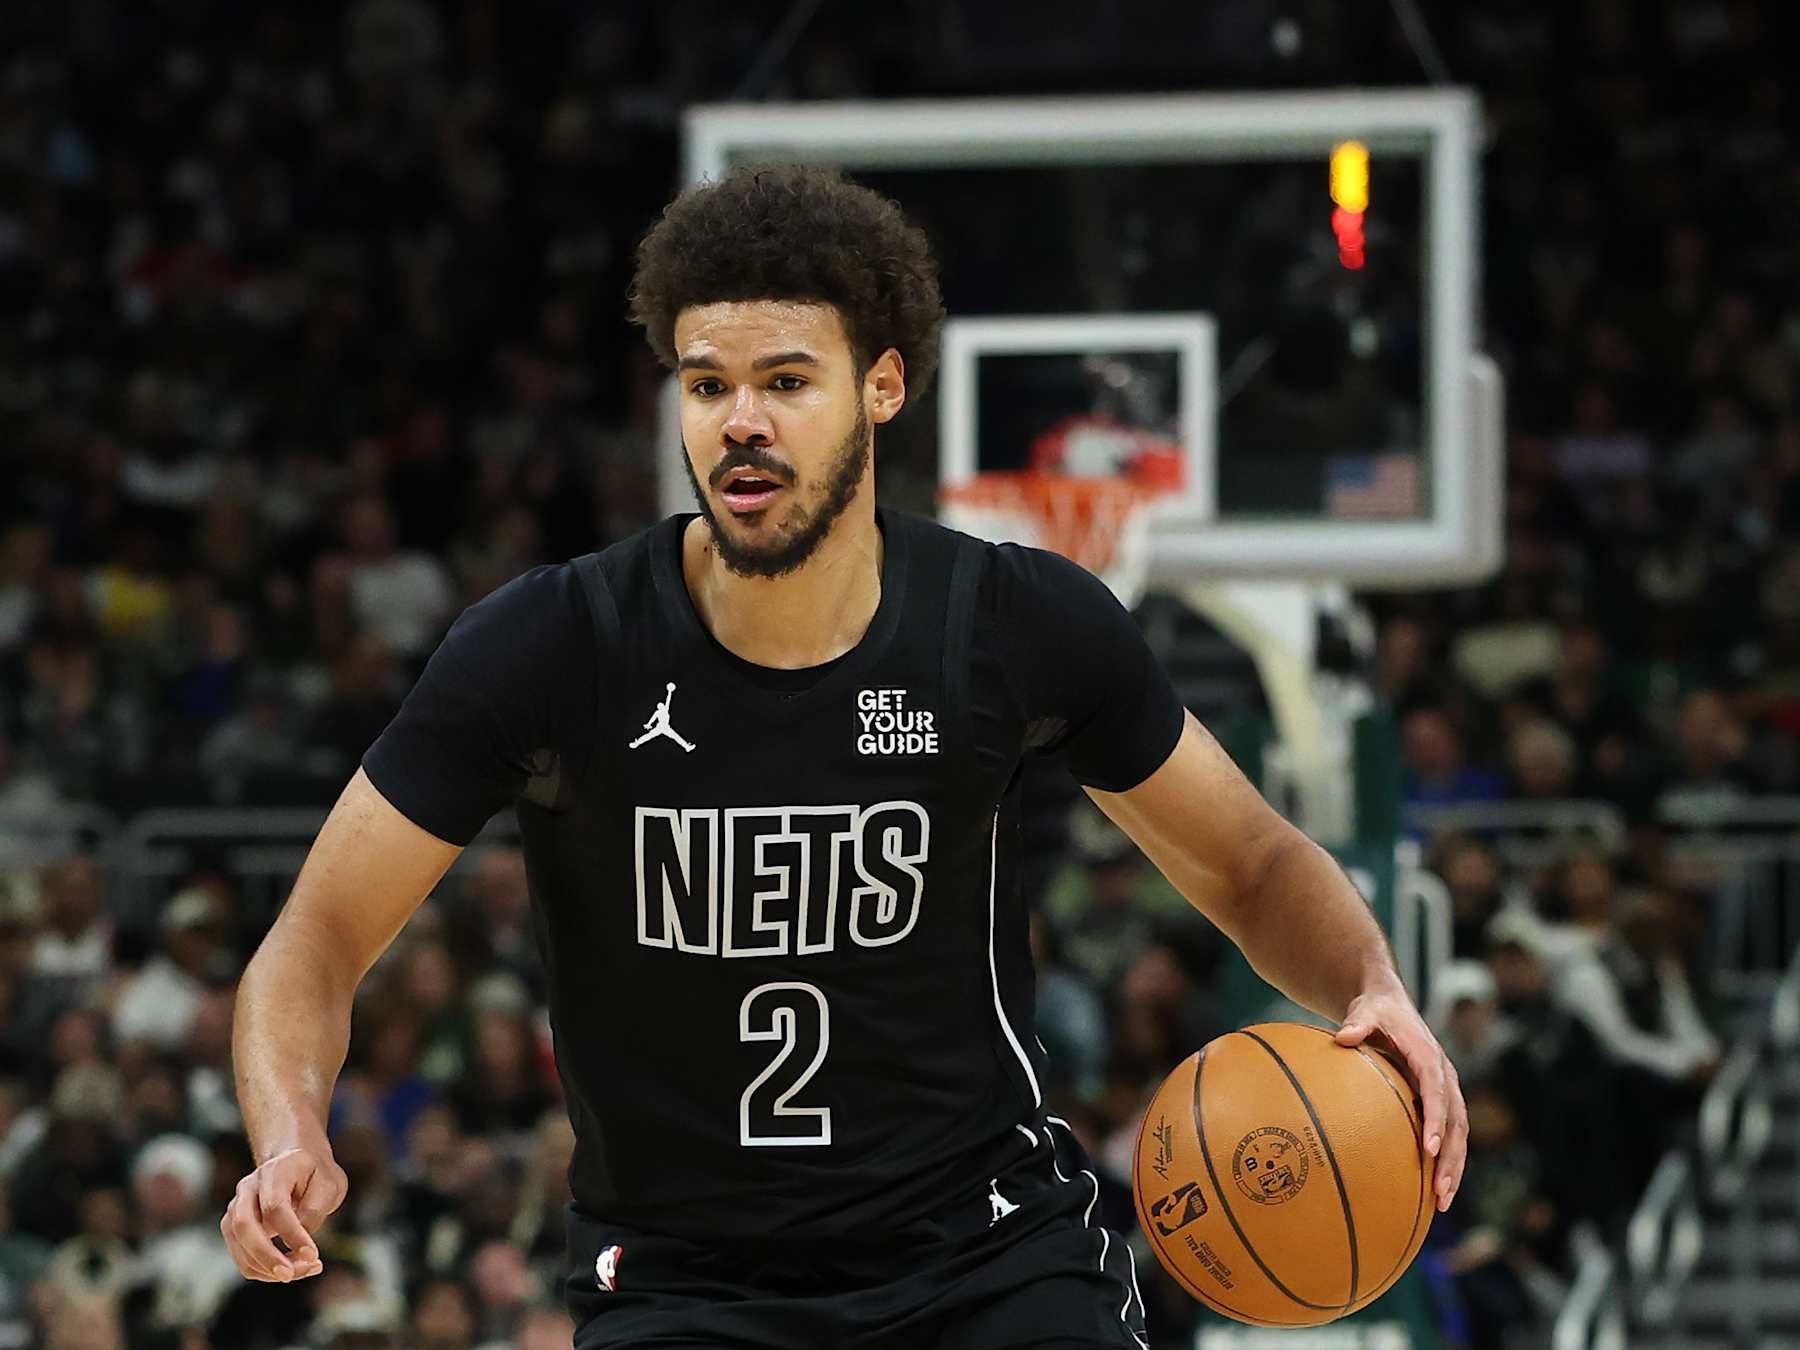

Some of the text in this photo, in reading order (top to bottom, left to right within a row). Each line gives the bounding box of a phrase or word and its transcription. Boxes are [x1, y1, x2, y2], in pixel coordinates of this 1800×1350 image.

[858, 689, 907, 711] GET
[858, 711, 934, 732] YOUR
[857, 733, 939, 754] GUIDE
[635, 801, 930, 958] NETS
[740, 982, 831, 1146] 2
